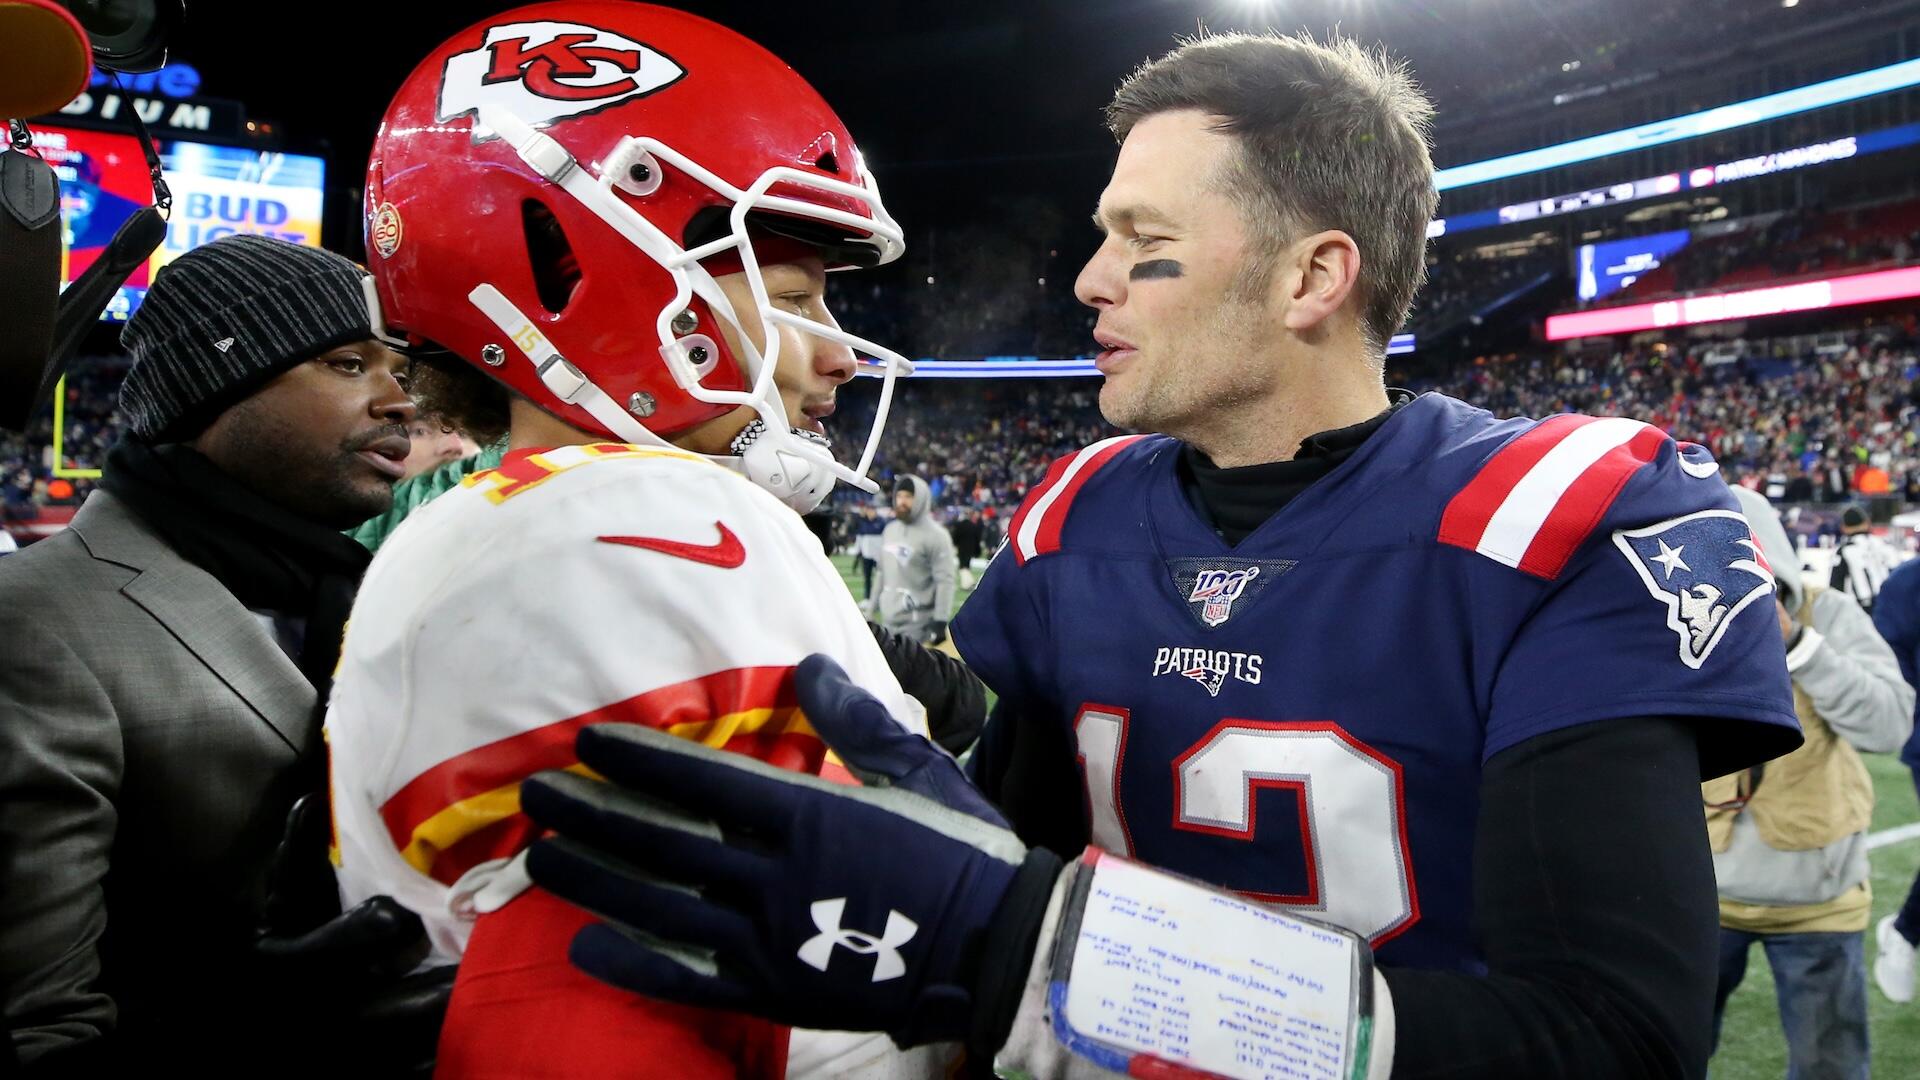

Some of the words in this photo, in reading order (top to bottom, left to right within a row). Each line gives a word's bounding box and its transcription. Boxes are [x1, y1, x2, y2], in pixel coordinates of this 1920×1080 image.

[482, 34, 641, 101] KC
[185, 193, 288, 225] BUD
[376, 224, 397, 239] 60
[512, 324, 543, 353] 15
[1206, 604, 1228, 619] NFL
[1152, 646, 1263, 685] PATRIOTS
[1074, 702, 1421, 948] 12
